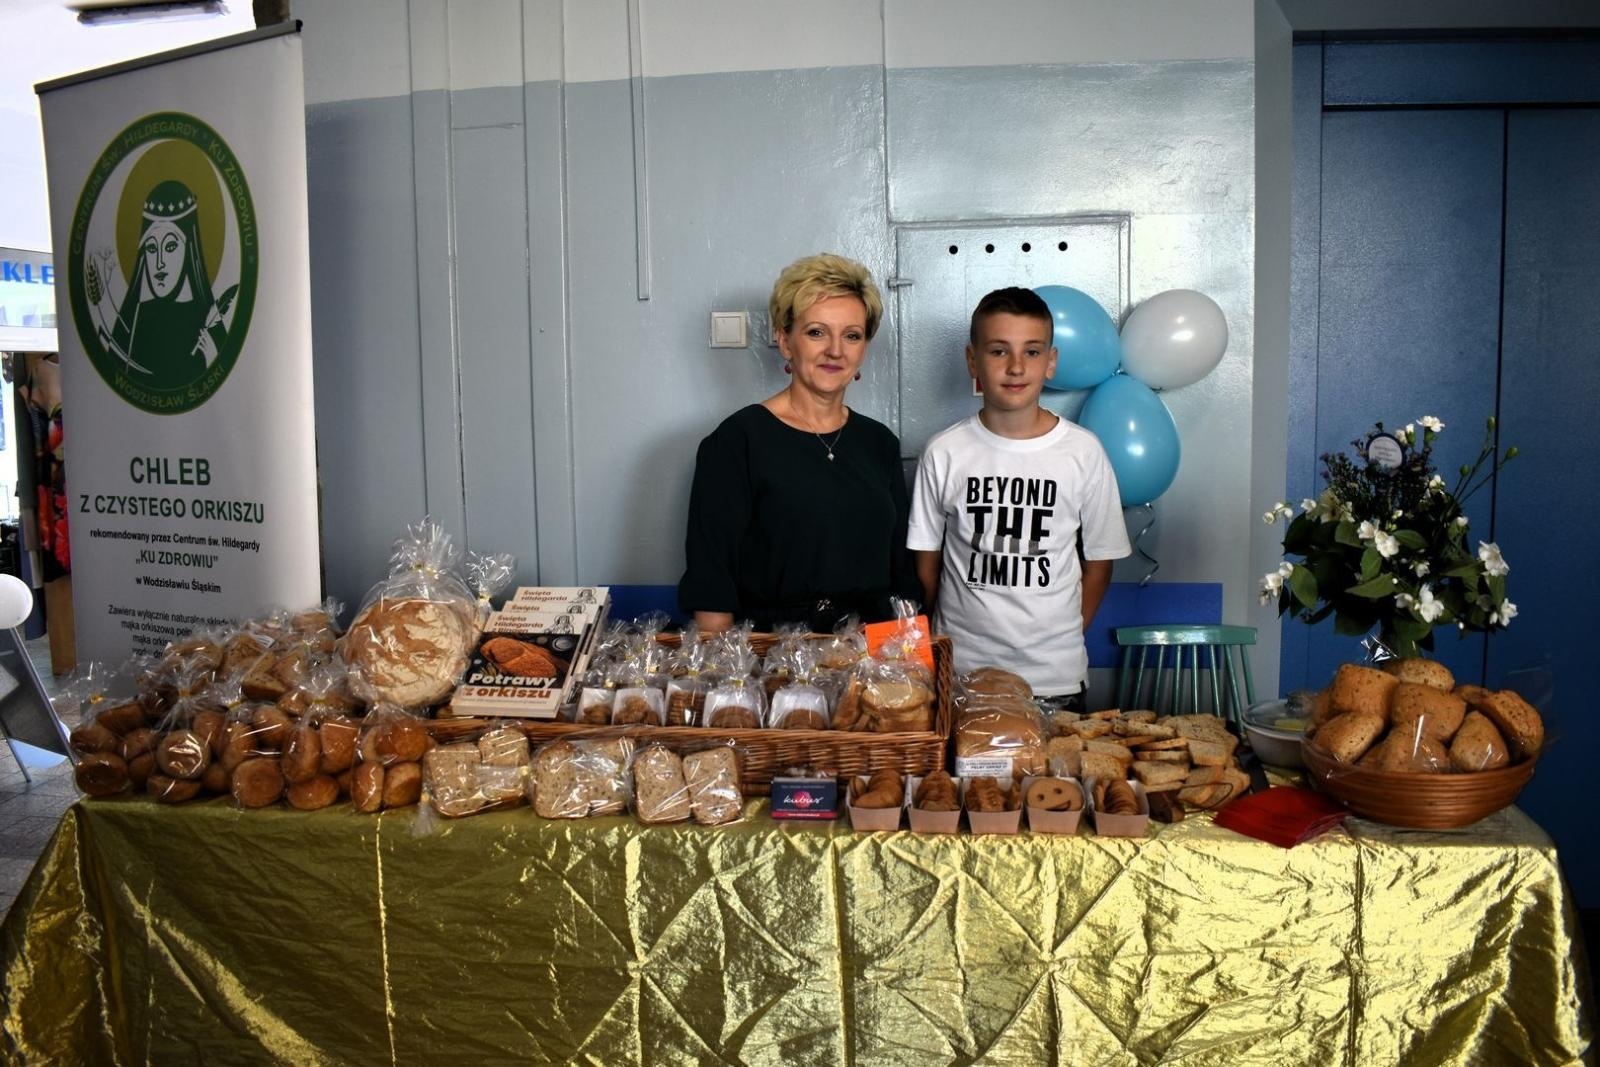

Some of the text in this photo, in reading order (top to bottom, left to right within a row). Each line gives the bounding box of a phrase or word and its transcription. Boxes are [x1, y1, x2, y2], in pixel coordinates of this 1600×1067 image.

[124, 121, 198, 147] HILDEGARDY
[208, 138, 253, 247] KU ZDROWIU
[3, 261, 54, 285] KLE
[129, 456, 211, 486] CHLEB
[966, 476, 1057, 507] BEYOND
[80, 494, 265, 524] Z CZYSTEGO ORKISZU
[90, 529, 260, 552] rekomendowany przez Centrum św. Hildegardy
[966, 506, 1054, 555] THE
[967, 552, 1051, 587] LIMITS
[143, 576, 190, 590] Wodzisławiu
[191, 578, 221, 593] Śląskim
[108, 604, 136, 617] Zawiera
[141, 622, 175, 635] orkiszowa
[464, 687, 551, 698] z orkiszu
[469, 673, 557, 689] Potrawy
